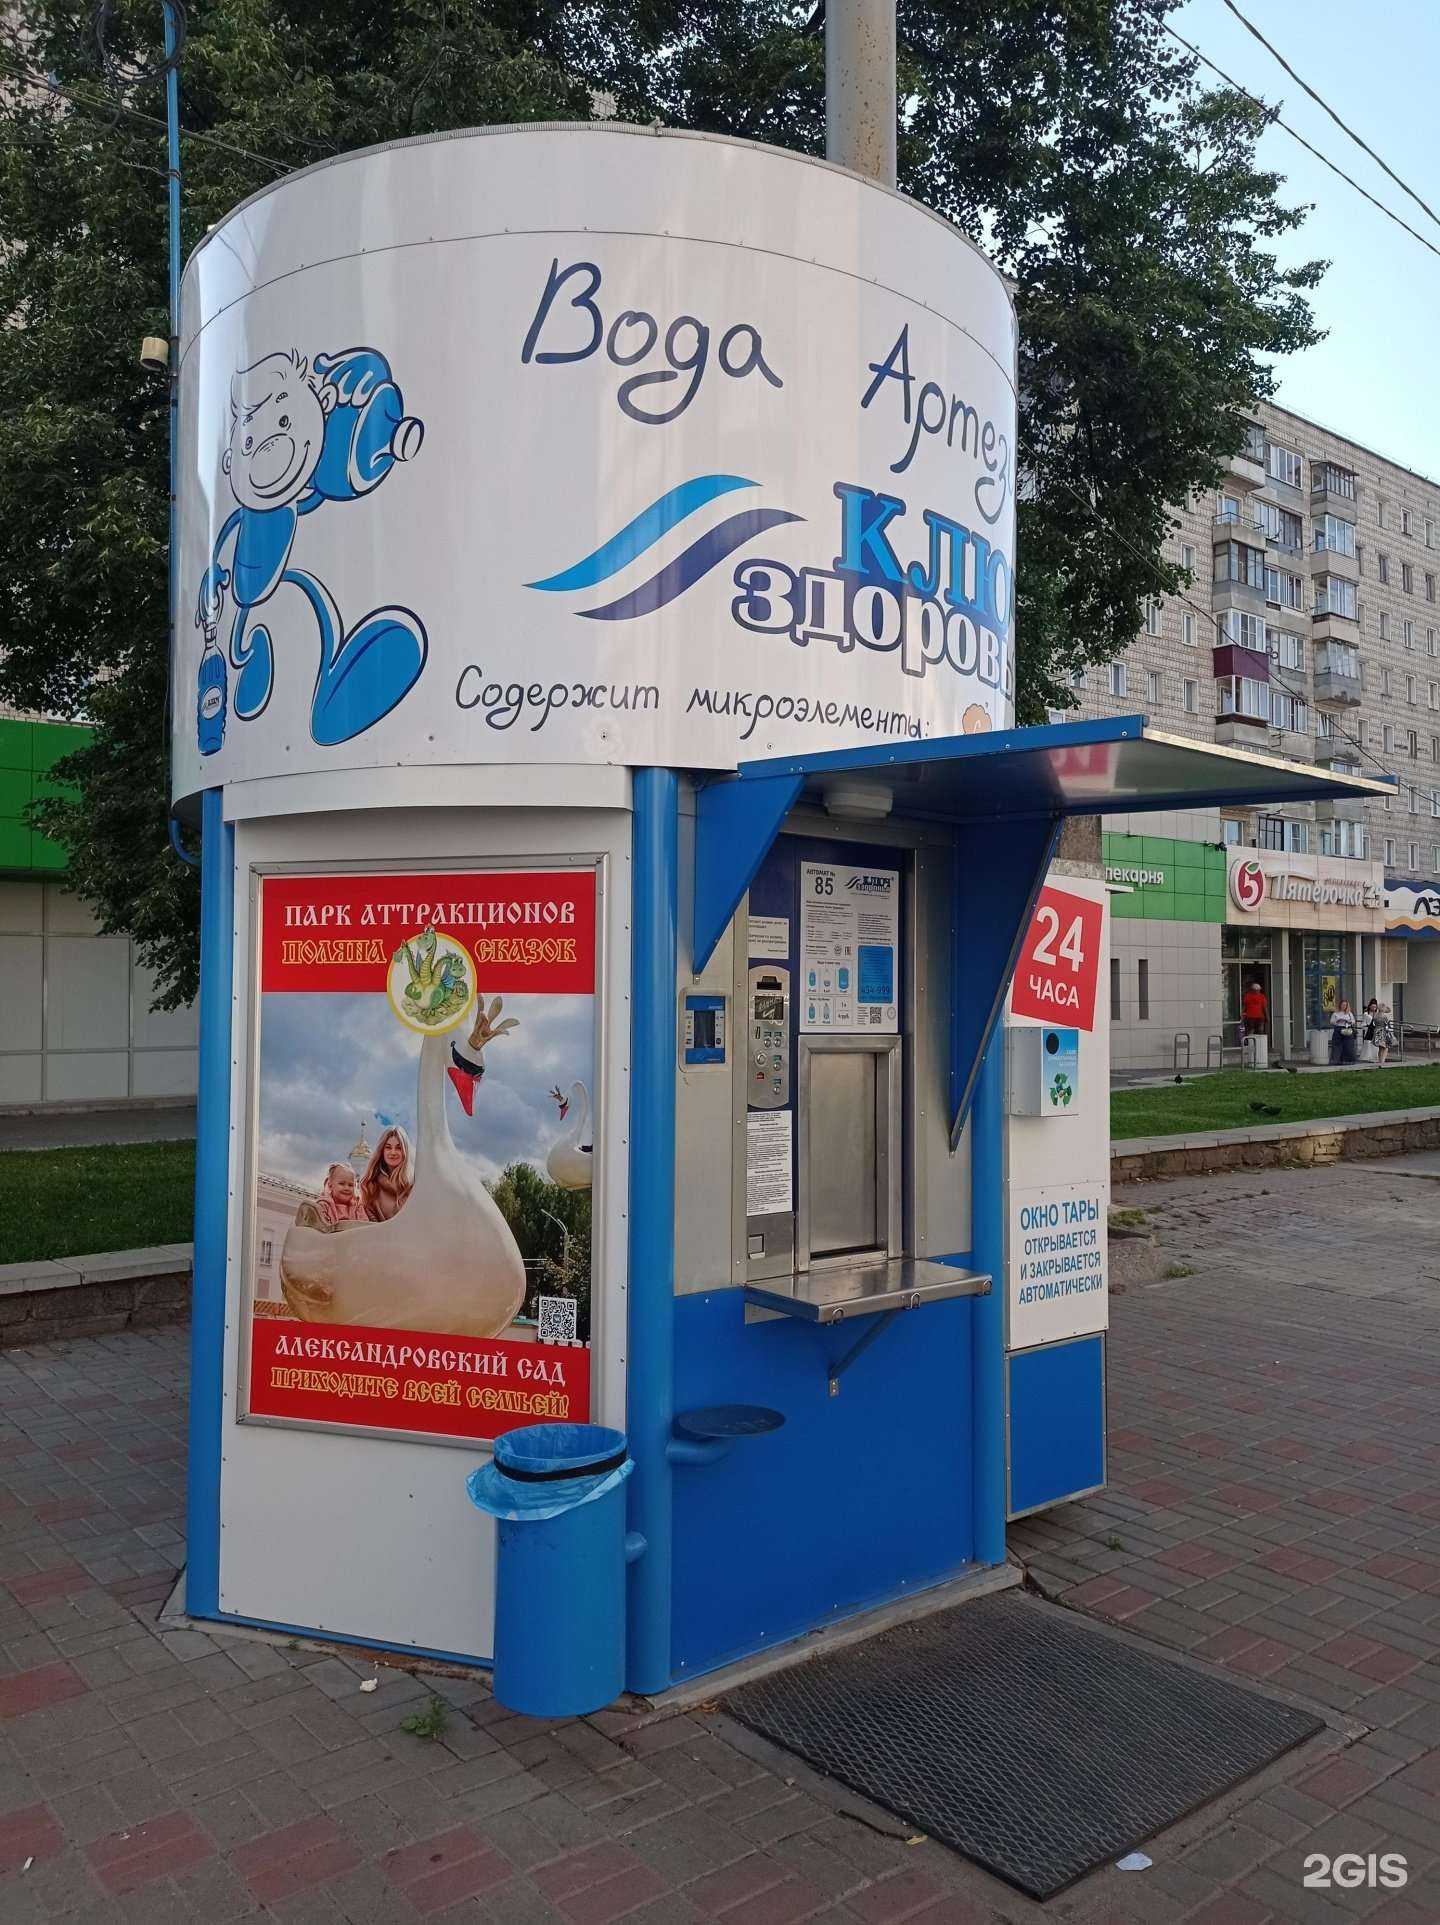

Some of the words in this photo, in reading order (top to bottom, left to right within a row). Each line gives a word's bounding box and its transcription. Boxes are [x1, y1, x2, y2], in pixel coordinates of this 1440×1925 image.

[521, 258, 783, 425] Вода
[861, 322, 1014, 525] Артез
[833, 481, 1015, 634] КЛЮ
[454, 664, 660, 731] Содержит
[686, 687, 931, 740] микроэлементы:
[815, 876, 834, 896] 85
[1105, 867, 1164, 887] пекарня
[284, 904, 352, 926] ПАРК
[360, 901, 576, 931] АТТРАКЦИОНОВ
[282, 939, 387, 964] ПОЛЯНА
[474, 938, 577, 965] СКАЗОК
[1032, 906, 1084, 972] 24
[1029, 974, 1080, 1009] ЧАСА
[1020, 1204, 1059, 1230] ОКНО
[1062, 1199, 1099, 1224] ТАРЫ
[1024, 1229, 1097, 1255] ОТКРЫВАЕТСЯ
[1020, 1263, 1027, 1280] И
[1030, 1251, 1101, 1279] ЗАКРЫВАЕТСЯ
[1019, 1274, 1102, 1304] АВТОМАТИЧЕСКИ
[275, 1335, 509, 1377] АЛЕКСАНДРОВСКИЙ
[517, 1358, 566, 1388] САД
[271, 1367, 399, 1398] ПРИХОДИТЕ
[402, 1380, 461, 1406] ВСЕЙ
[466, 1387, 570, 1419] СЕМЬЕЙ!
